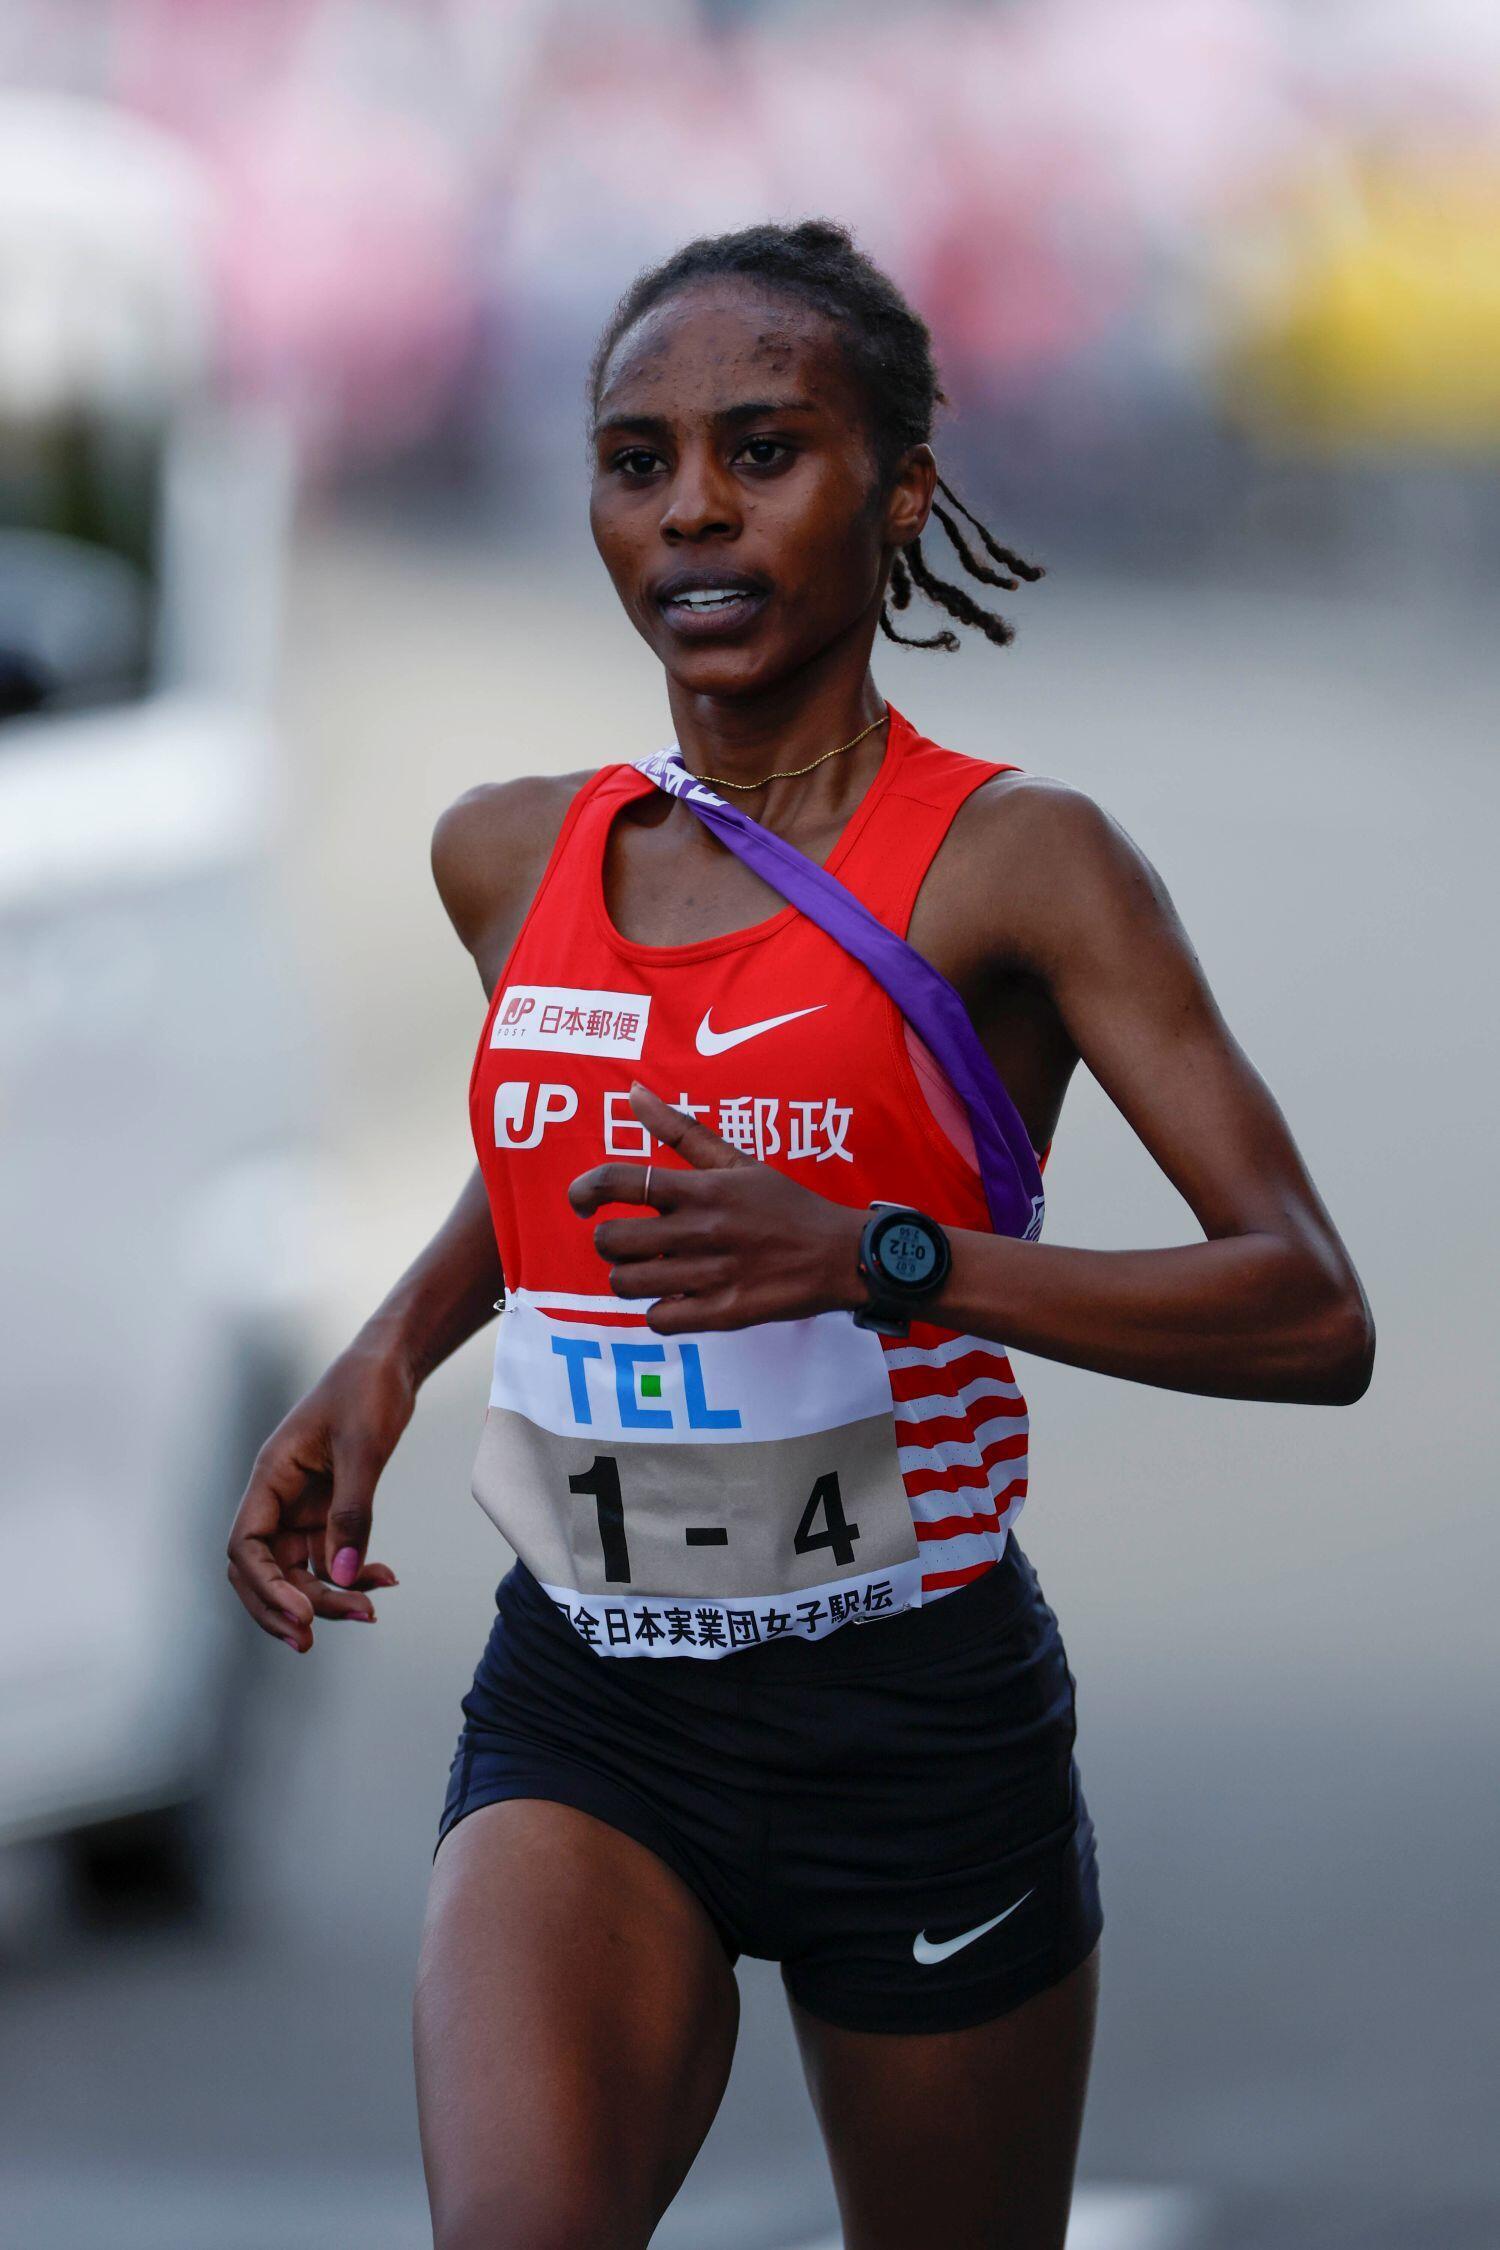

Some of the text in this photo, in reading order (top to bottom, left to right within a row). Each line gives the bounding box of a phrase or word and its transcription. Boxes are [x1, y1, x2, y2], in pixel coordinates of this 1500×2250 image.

[497, 1028, 527, 1037] POST
[539, 1005, 640, 1042] 日本郵便
[494, 1081, 579, 1149] JP
[551, 1335, 742, 1429] TEL
